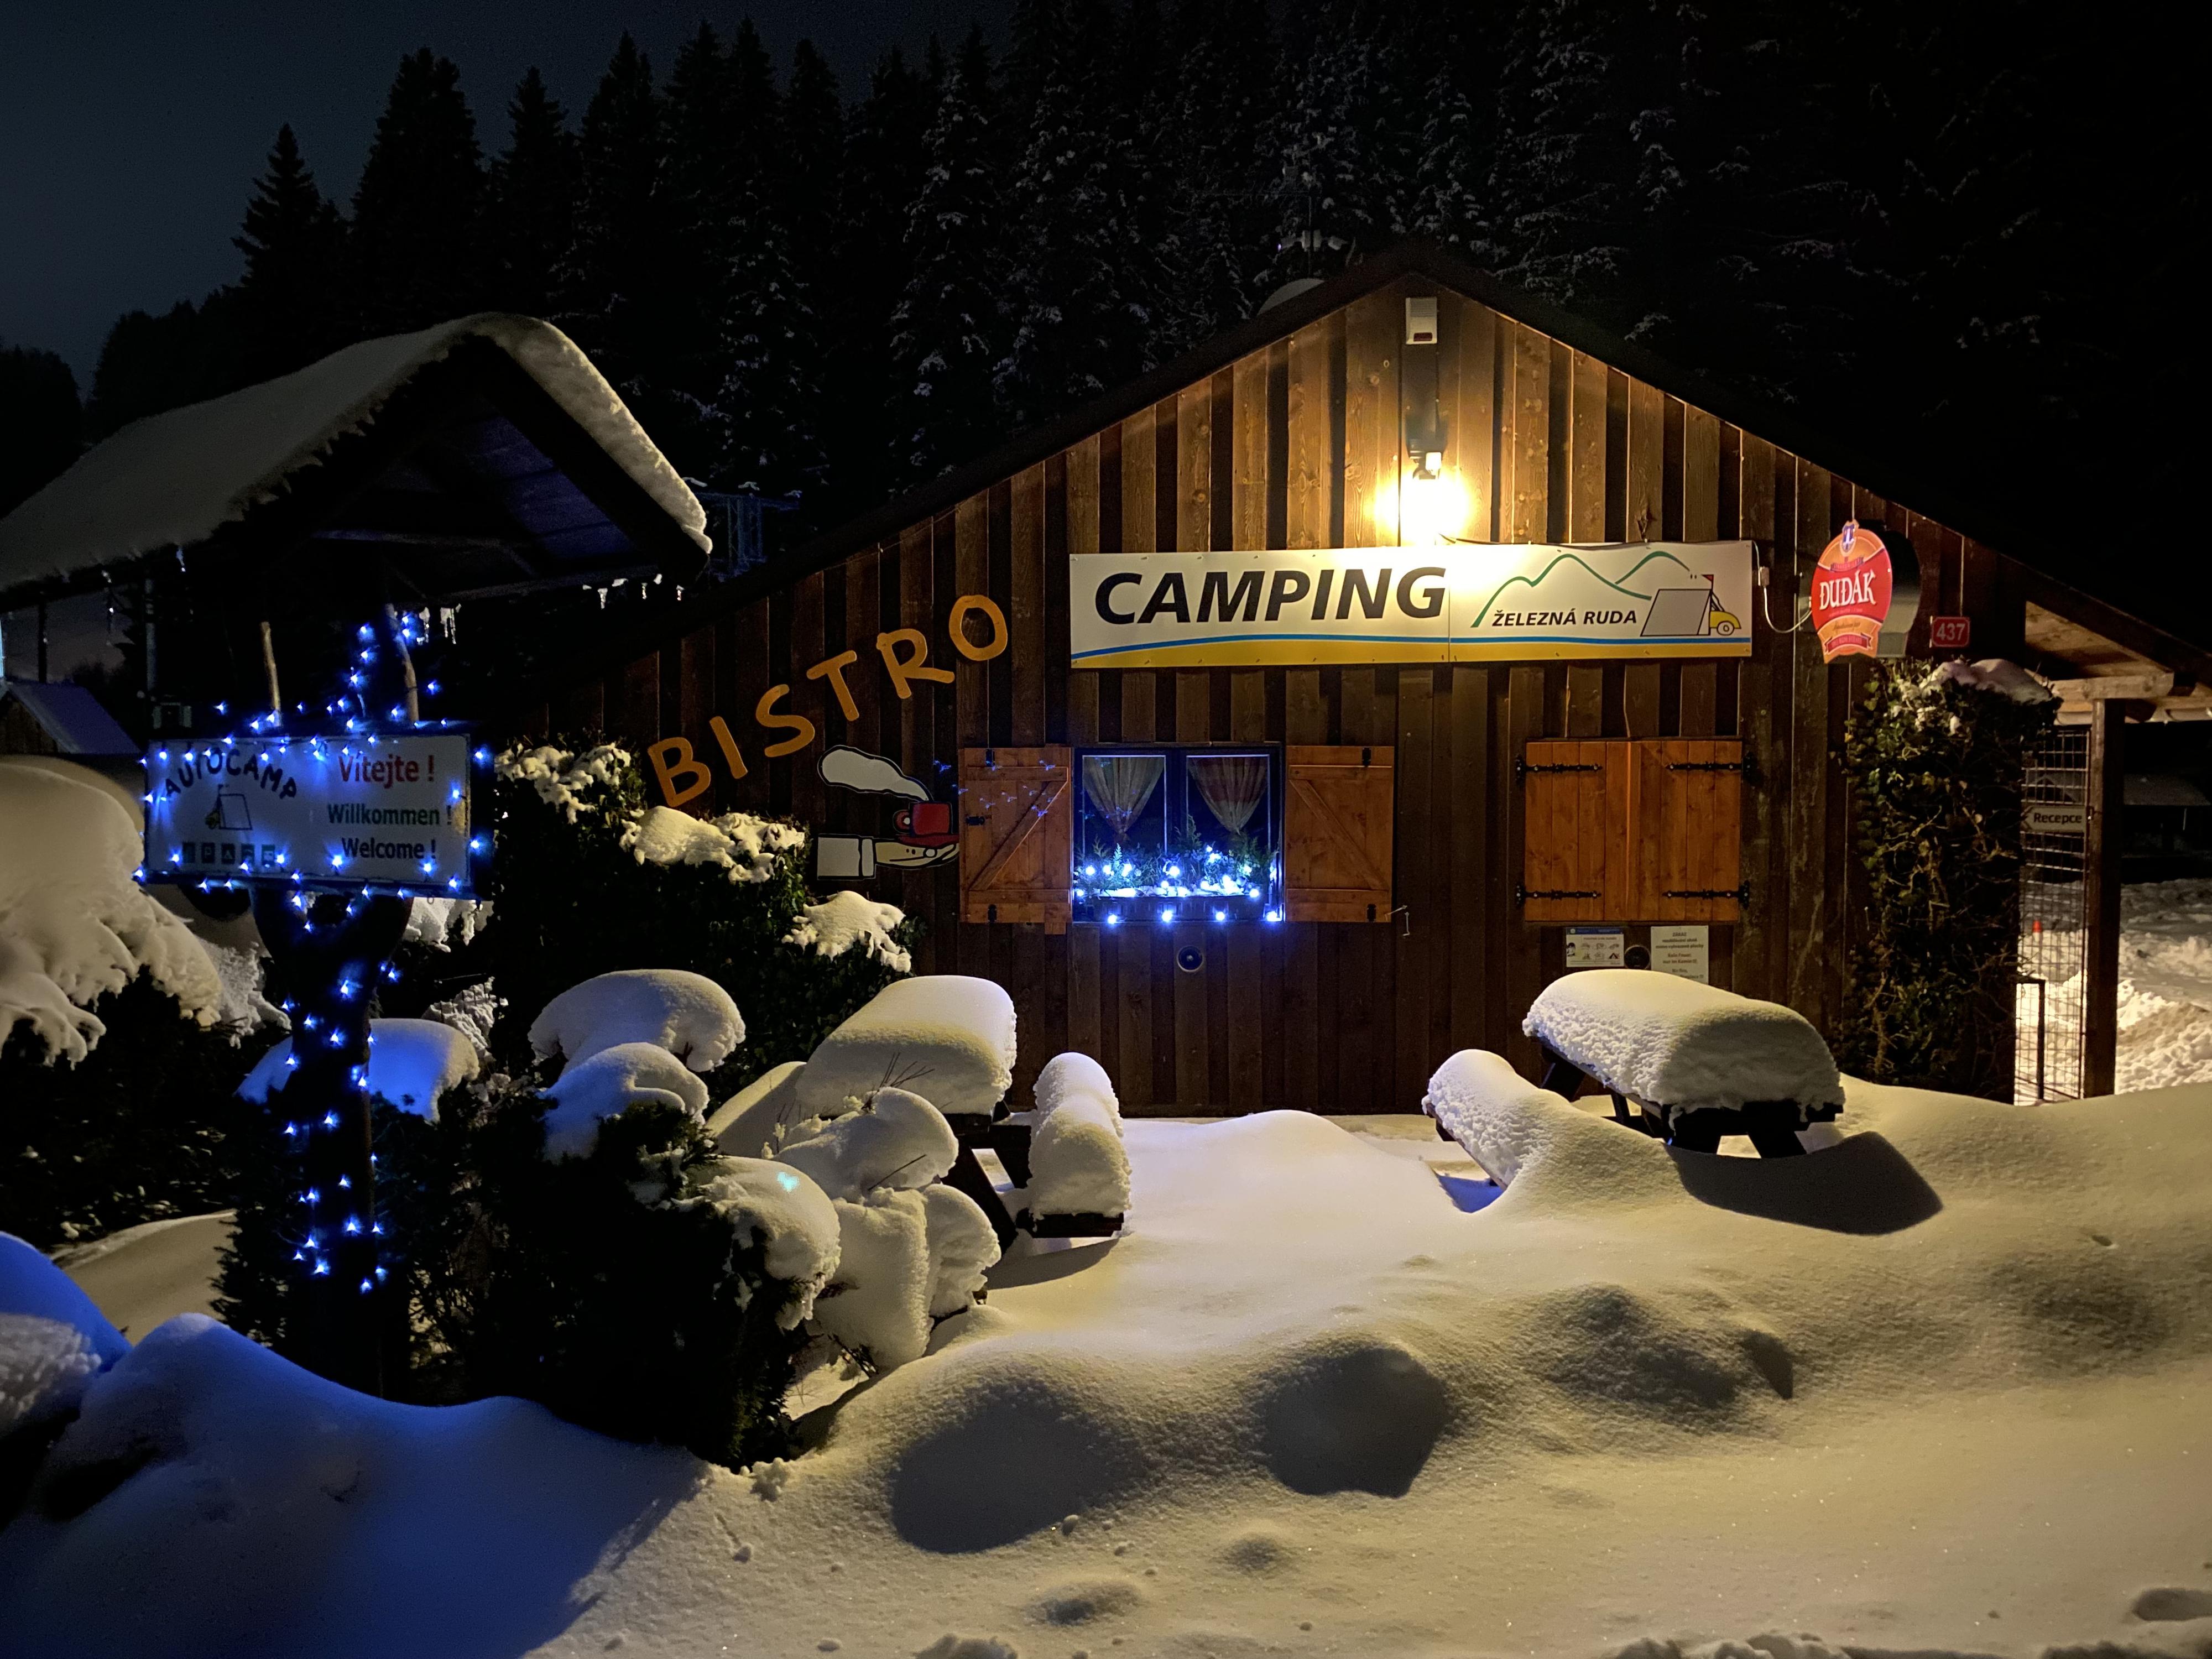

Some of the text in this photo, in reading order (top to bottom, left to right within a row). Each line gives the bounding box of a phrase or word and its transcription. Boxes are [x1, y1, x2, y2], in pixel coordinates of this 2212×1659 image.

[1095, 566, 1446, 625] CAMPING
[1819, 568, 1876, 611] DUDÁK
[1491, 608, 1637, 627] ŽELEZNÁ RUDA
[1936, 623, 1965, 641] 437
[646, 594, 1008, 807] BISTRO
[328, 803, 440, 825] Willkommen
[2033, 812, 2083, 825] Recepce
[342, 837, 425, 859] Welcome
